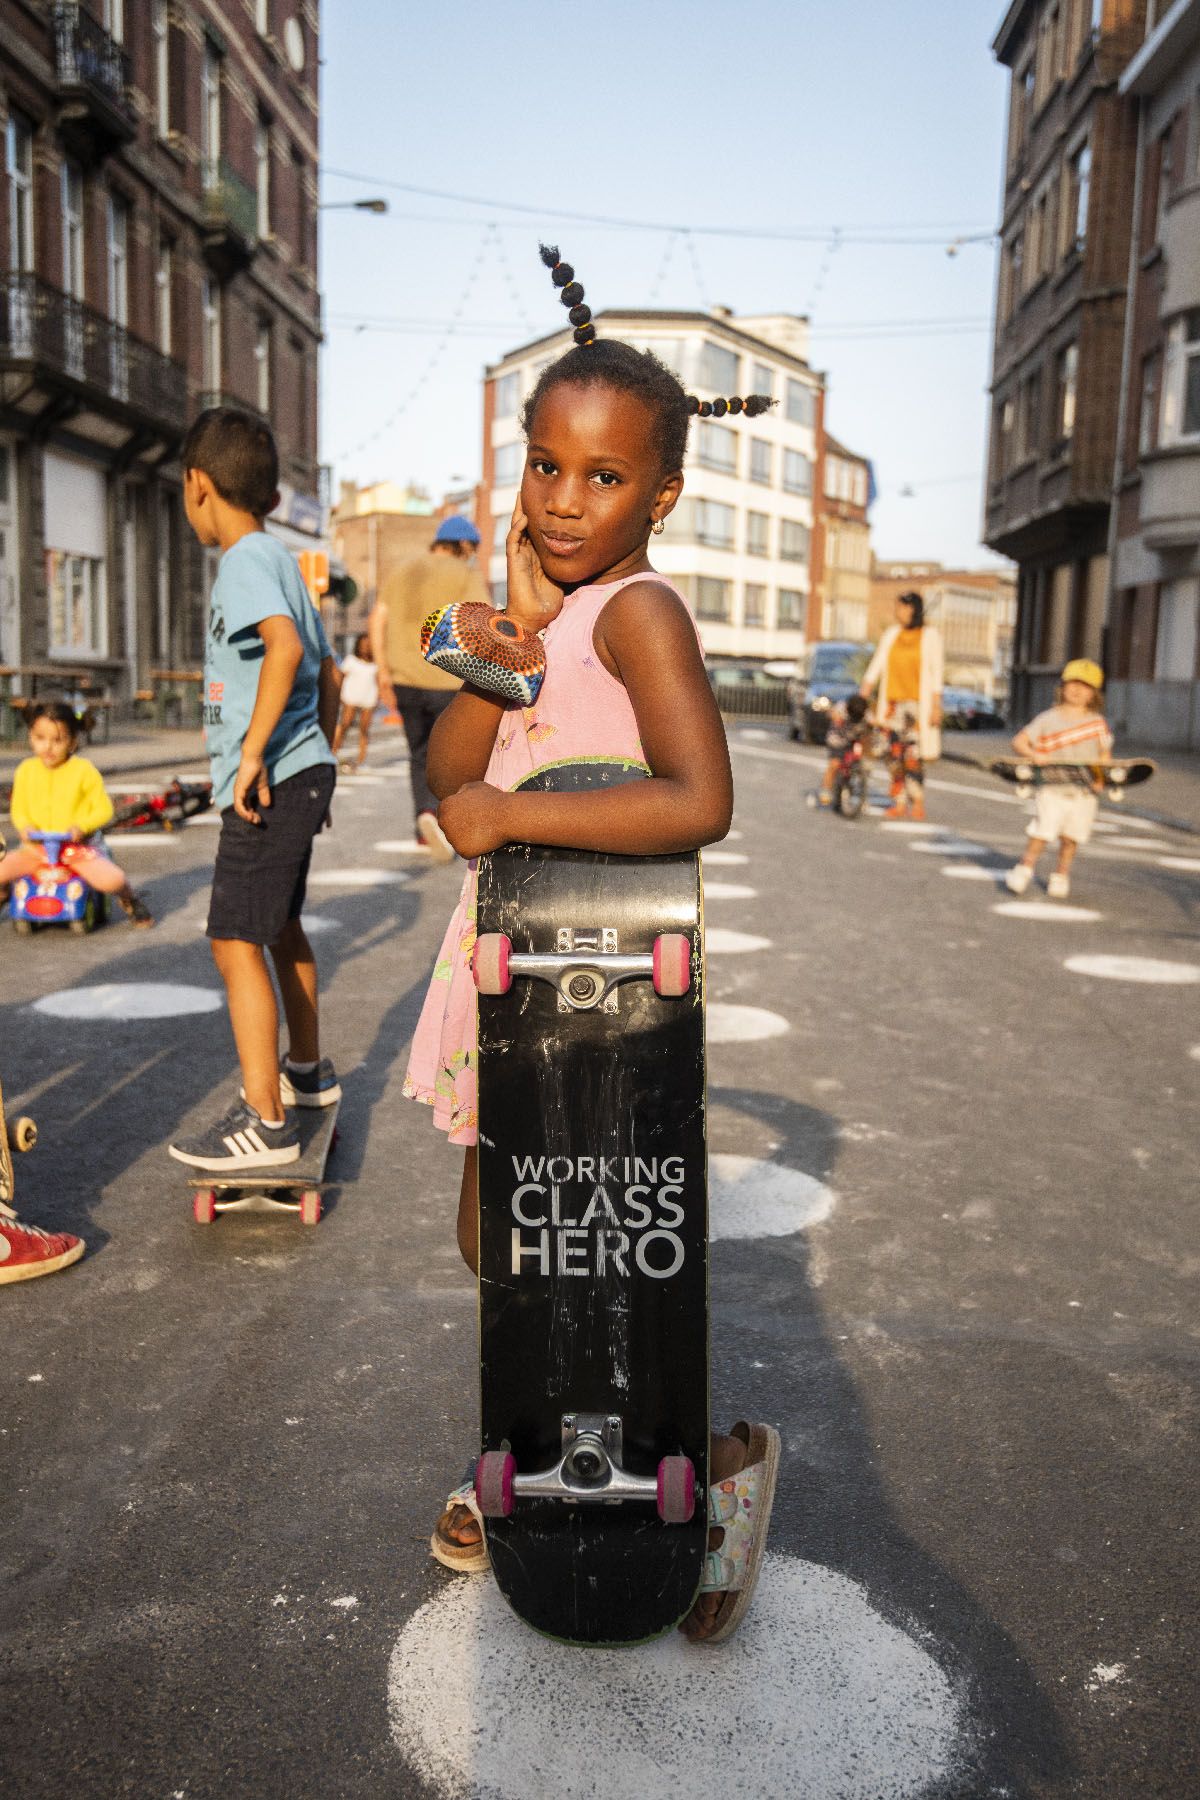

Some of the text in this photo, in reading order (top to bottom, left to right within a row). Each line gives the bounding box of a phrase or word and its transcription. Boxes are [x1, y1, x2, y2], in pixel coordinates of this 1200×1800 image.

[511, 1155, 685, 1184] WORKING
[511, 1183, 685, 1229] CLASS
[511, 1227, 685, 1279] HERO
